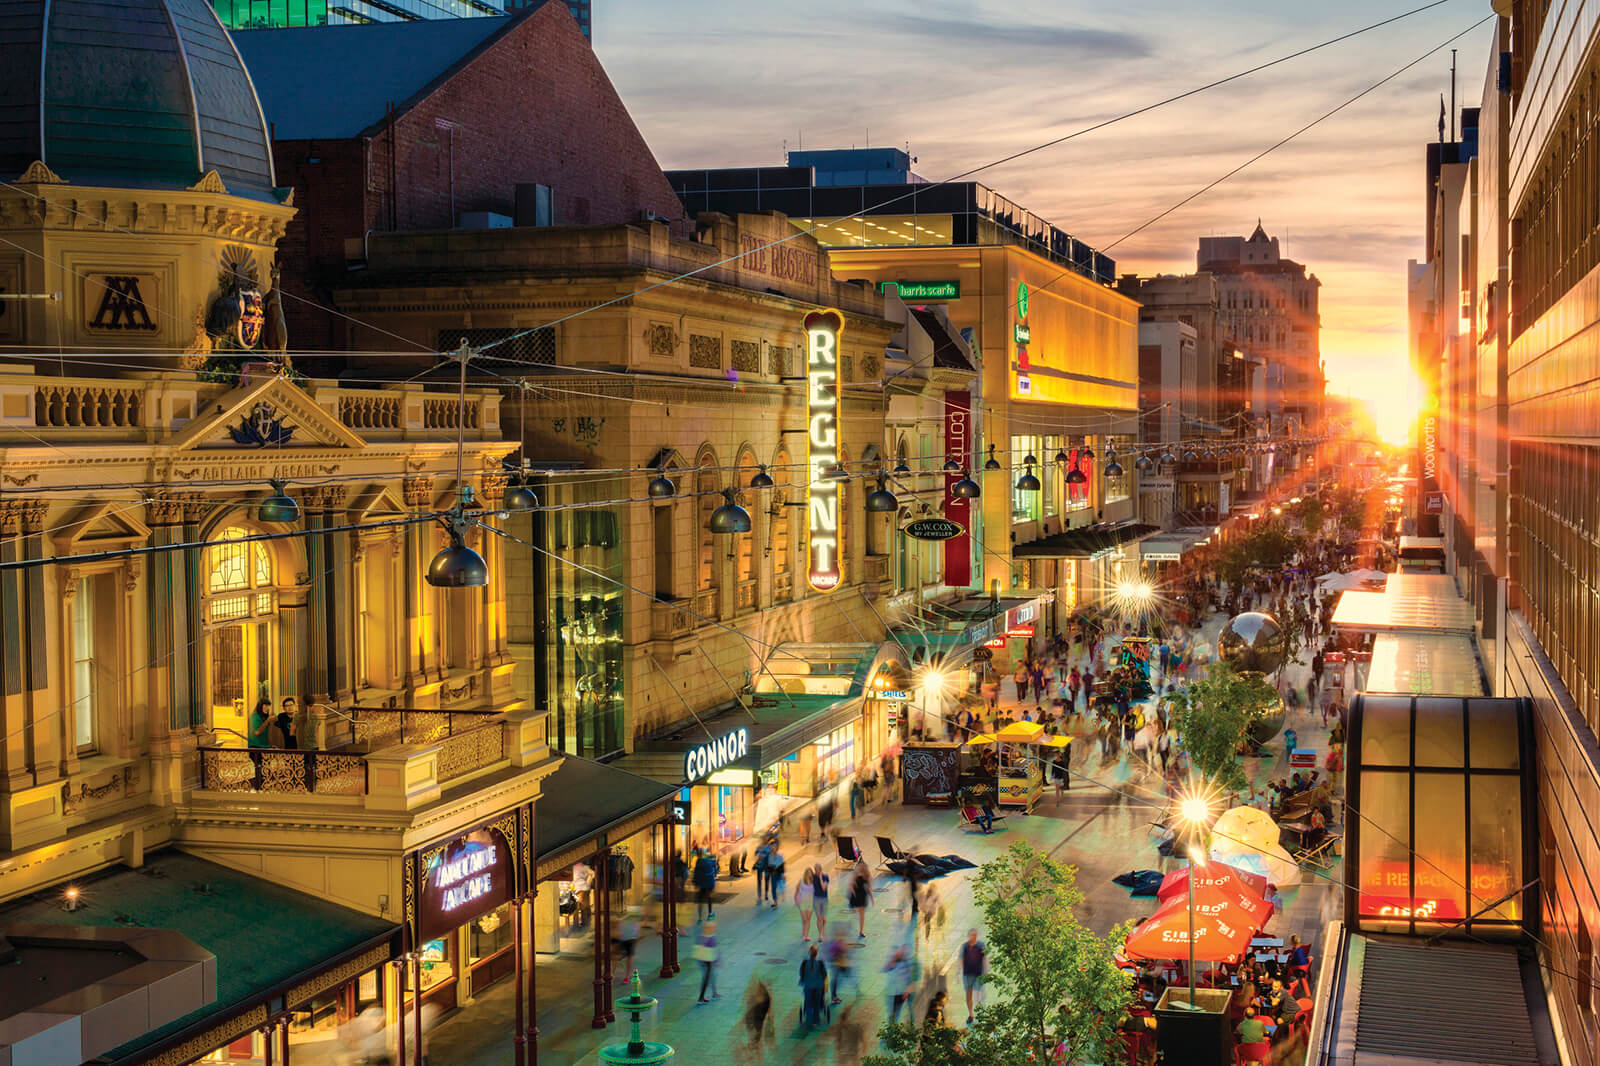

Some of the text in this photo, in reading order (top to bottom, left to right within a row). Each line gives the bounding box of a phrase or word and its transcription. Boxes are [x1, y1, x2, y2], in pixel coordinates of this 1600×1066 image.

[741, 235, 817, 286] THE REGENT
[808, 330, 837, 573] REGENT
[687, 728, 747, 781] CONNOR
